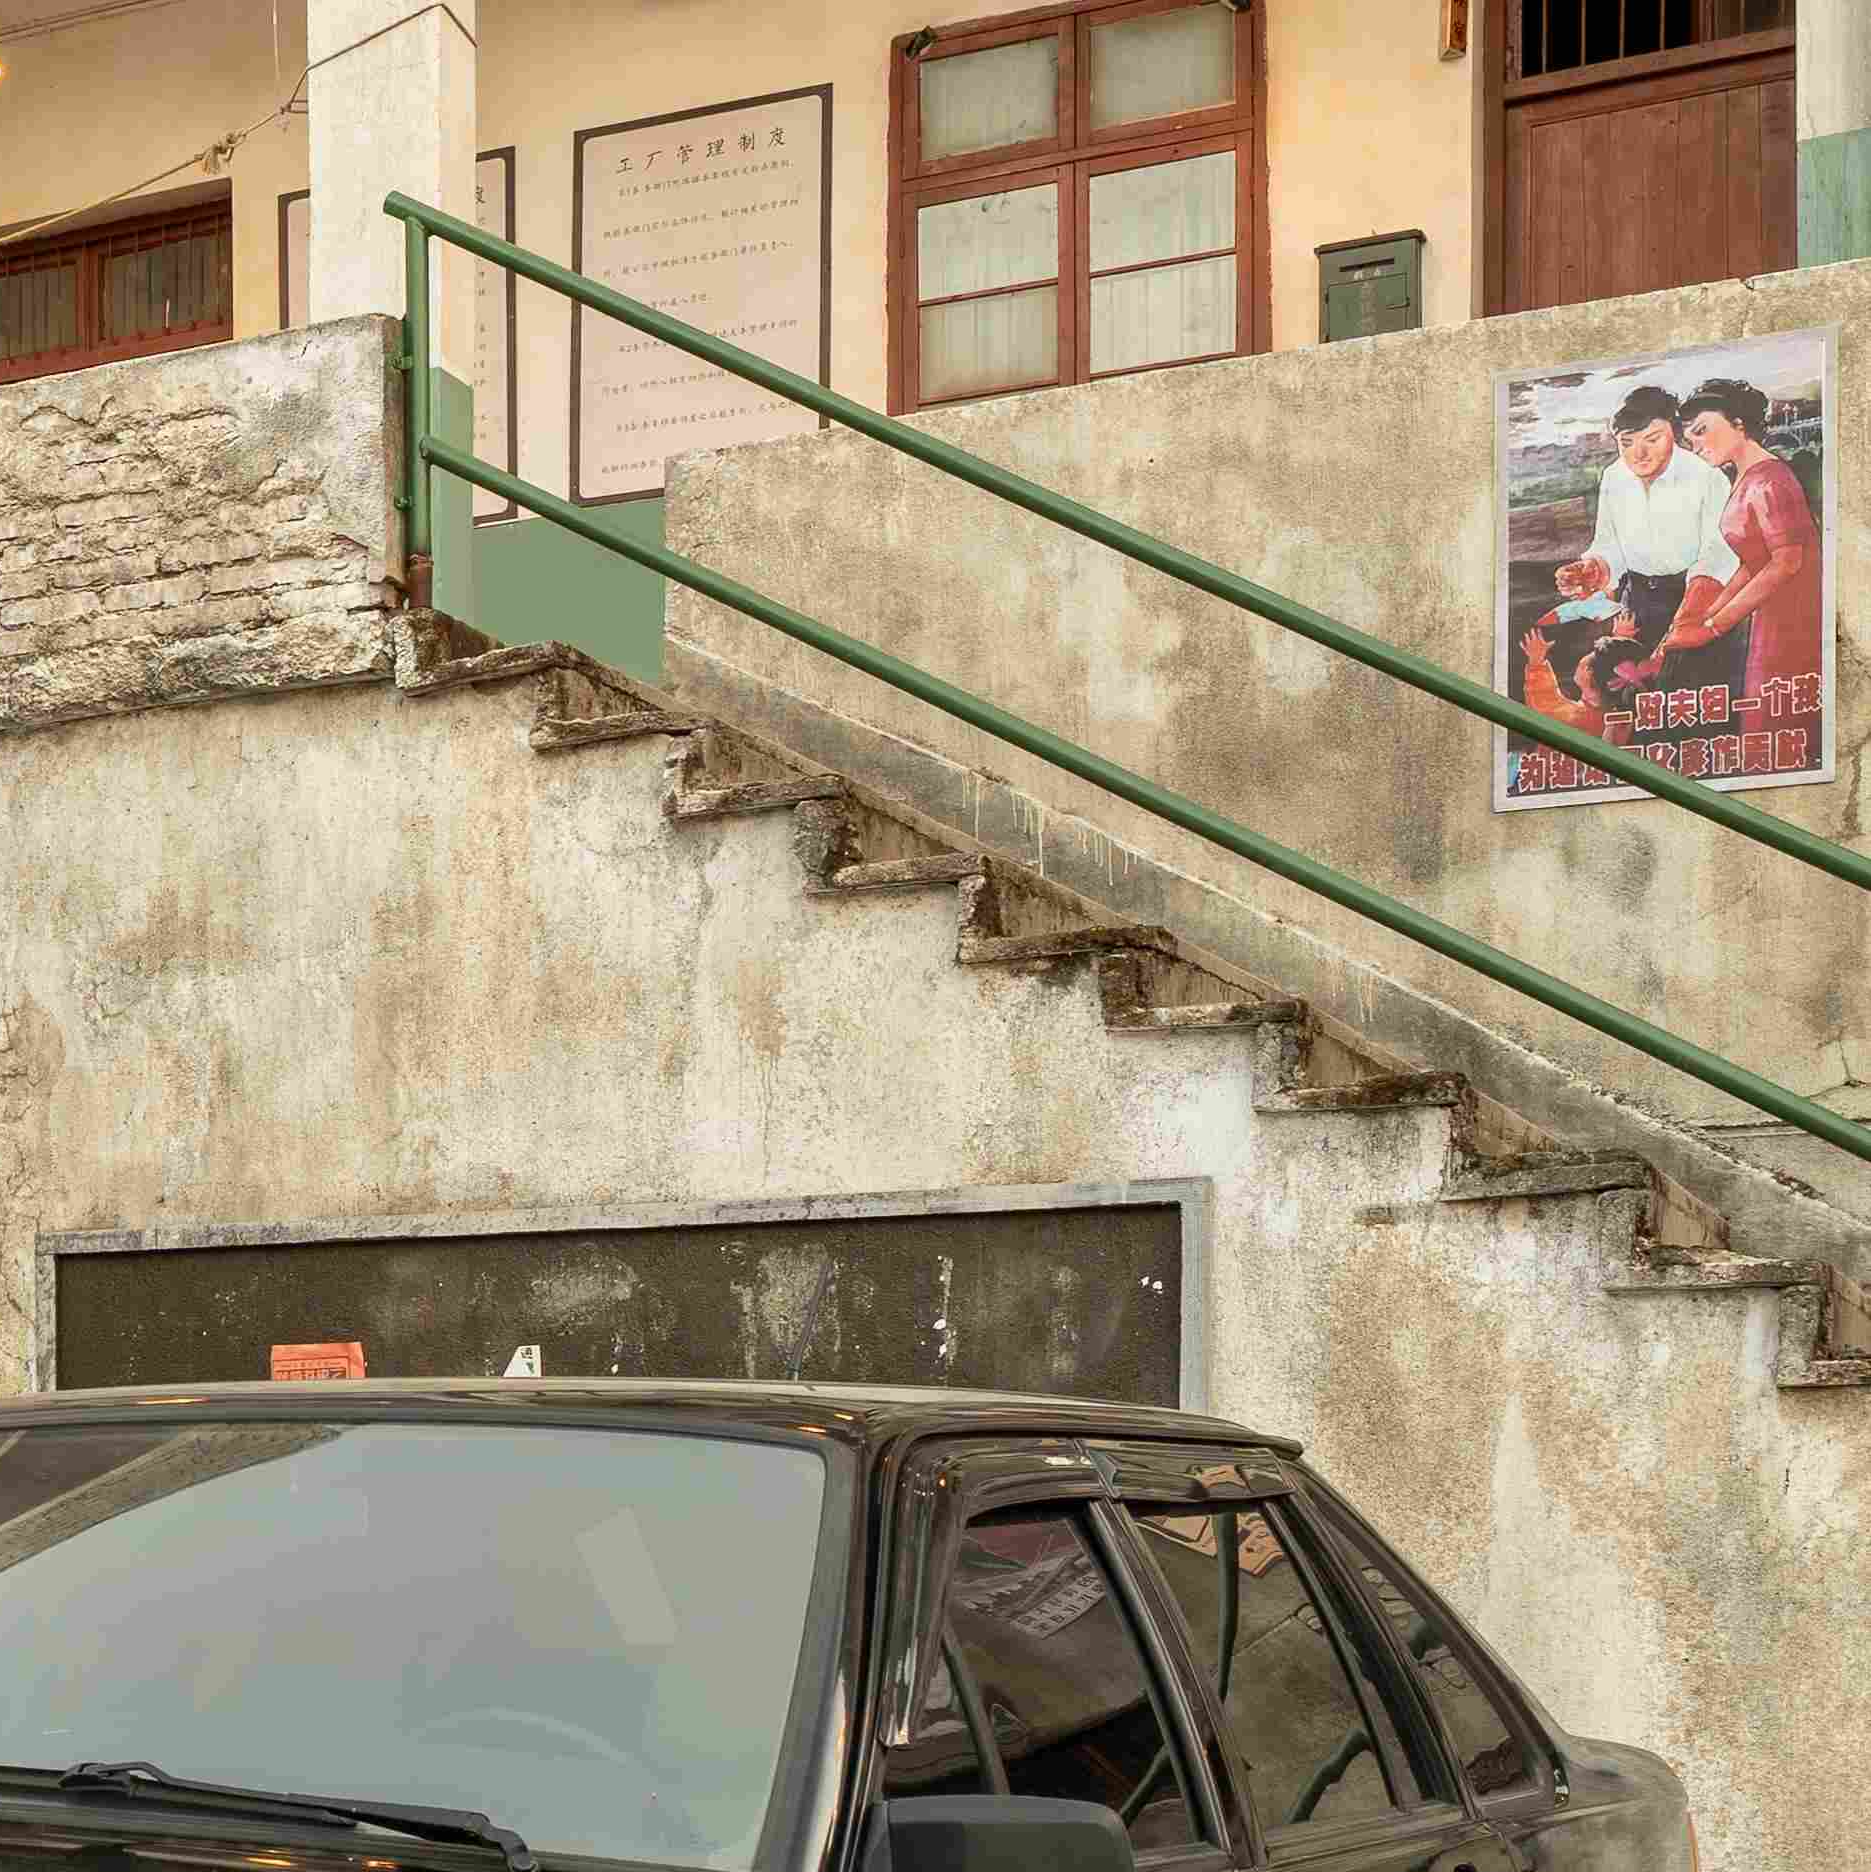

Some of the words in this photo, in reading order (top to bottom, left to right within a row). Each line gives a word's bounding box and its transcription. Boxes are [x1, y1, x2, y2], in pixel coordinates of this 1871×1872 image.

[615, 126, 788, 175] 工厂管理制度
